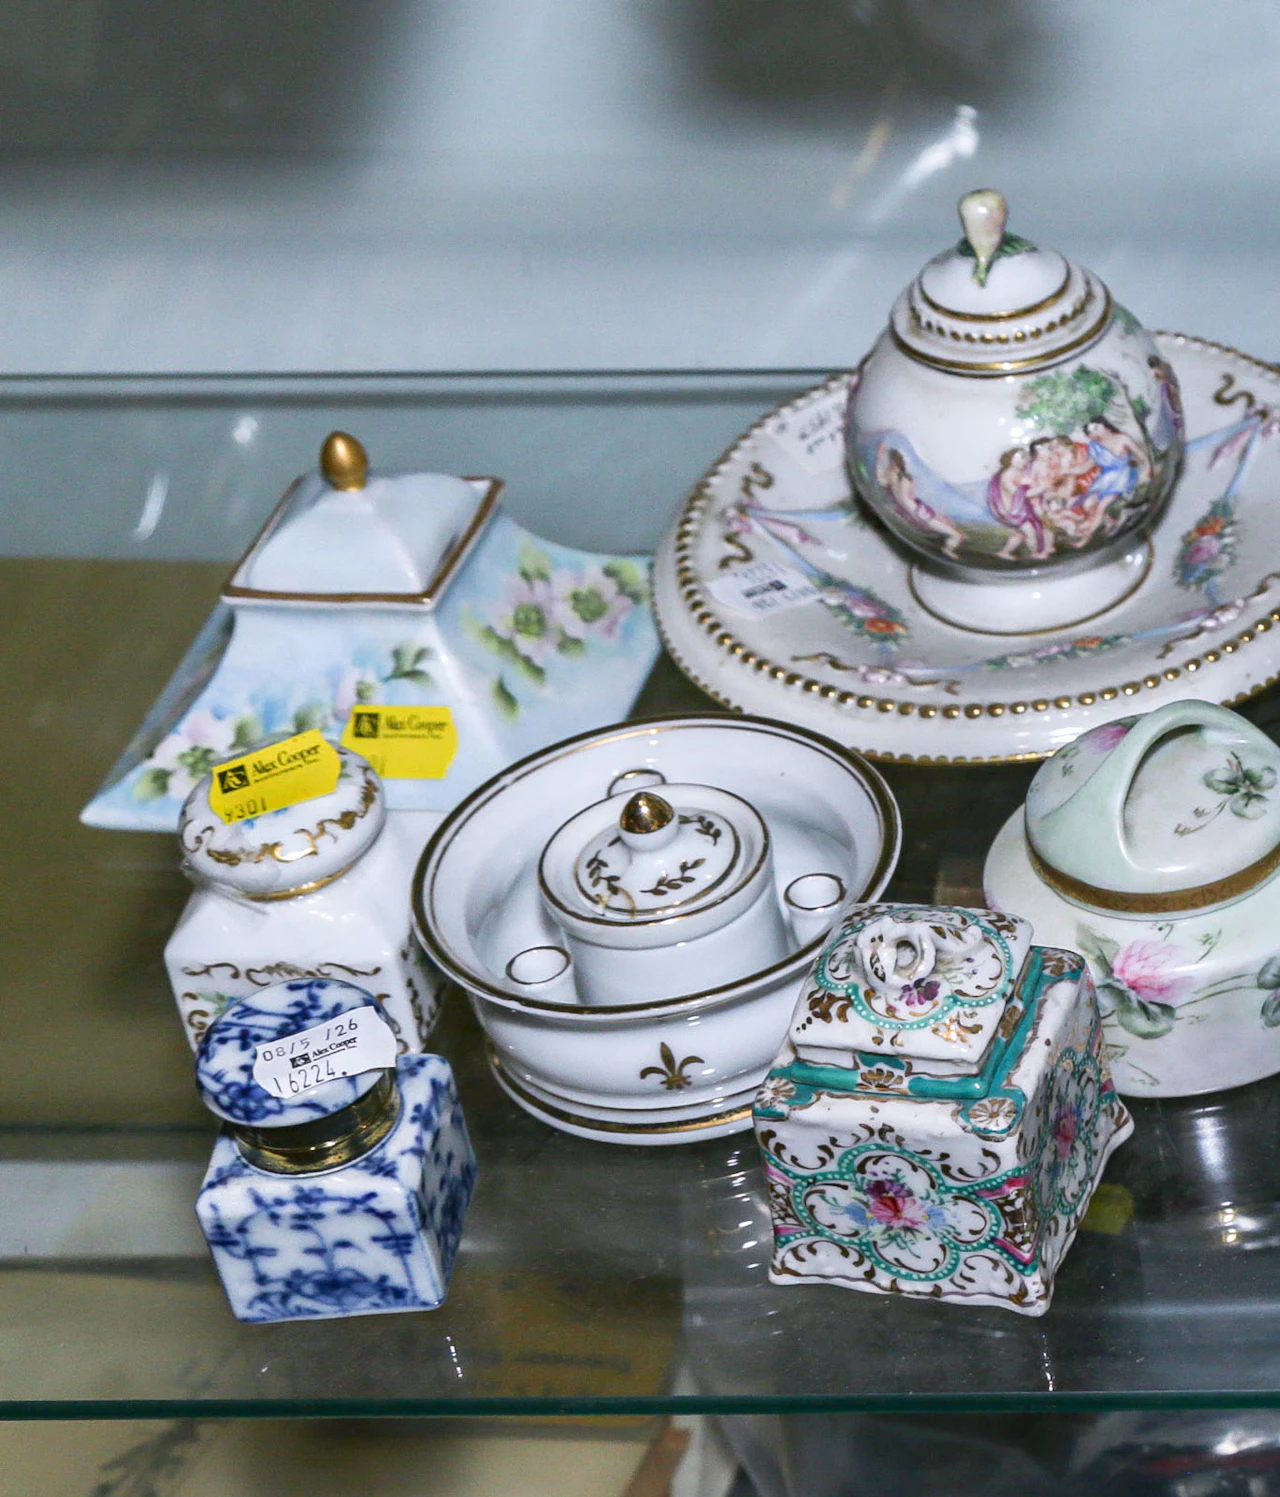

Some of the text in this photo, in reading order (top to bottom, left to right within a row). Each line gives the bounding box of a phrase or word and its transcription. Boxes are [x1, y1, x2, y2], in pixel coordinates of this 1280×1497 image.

[252, 760, 278, 777] Alex
[277, 744, 320, 767] Cooper
[223, 796, 268, 823] 9301
[262, 1037, 310, 1061] 08/5
[325, 1018, 358, 1041] /26
[311, 1047, 330, 1058] Alex
[329, 1037, 358, 1051] Cooper
